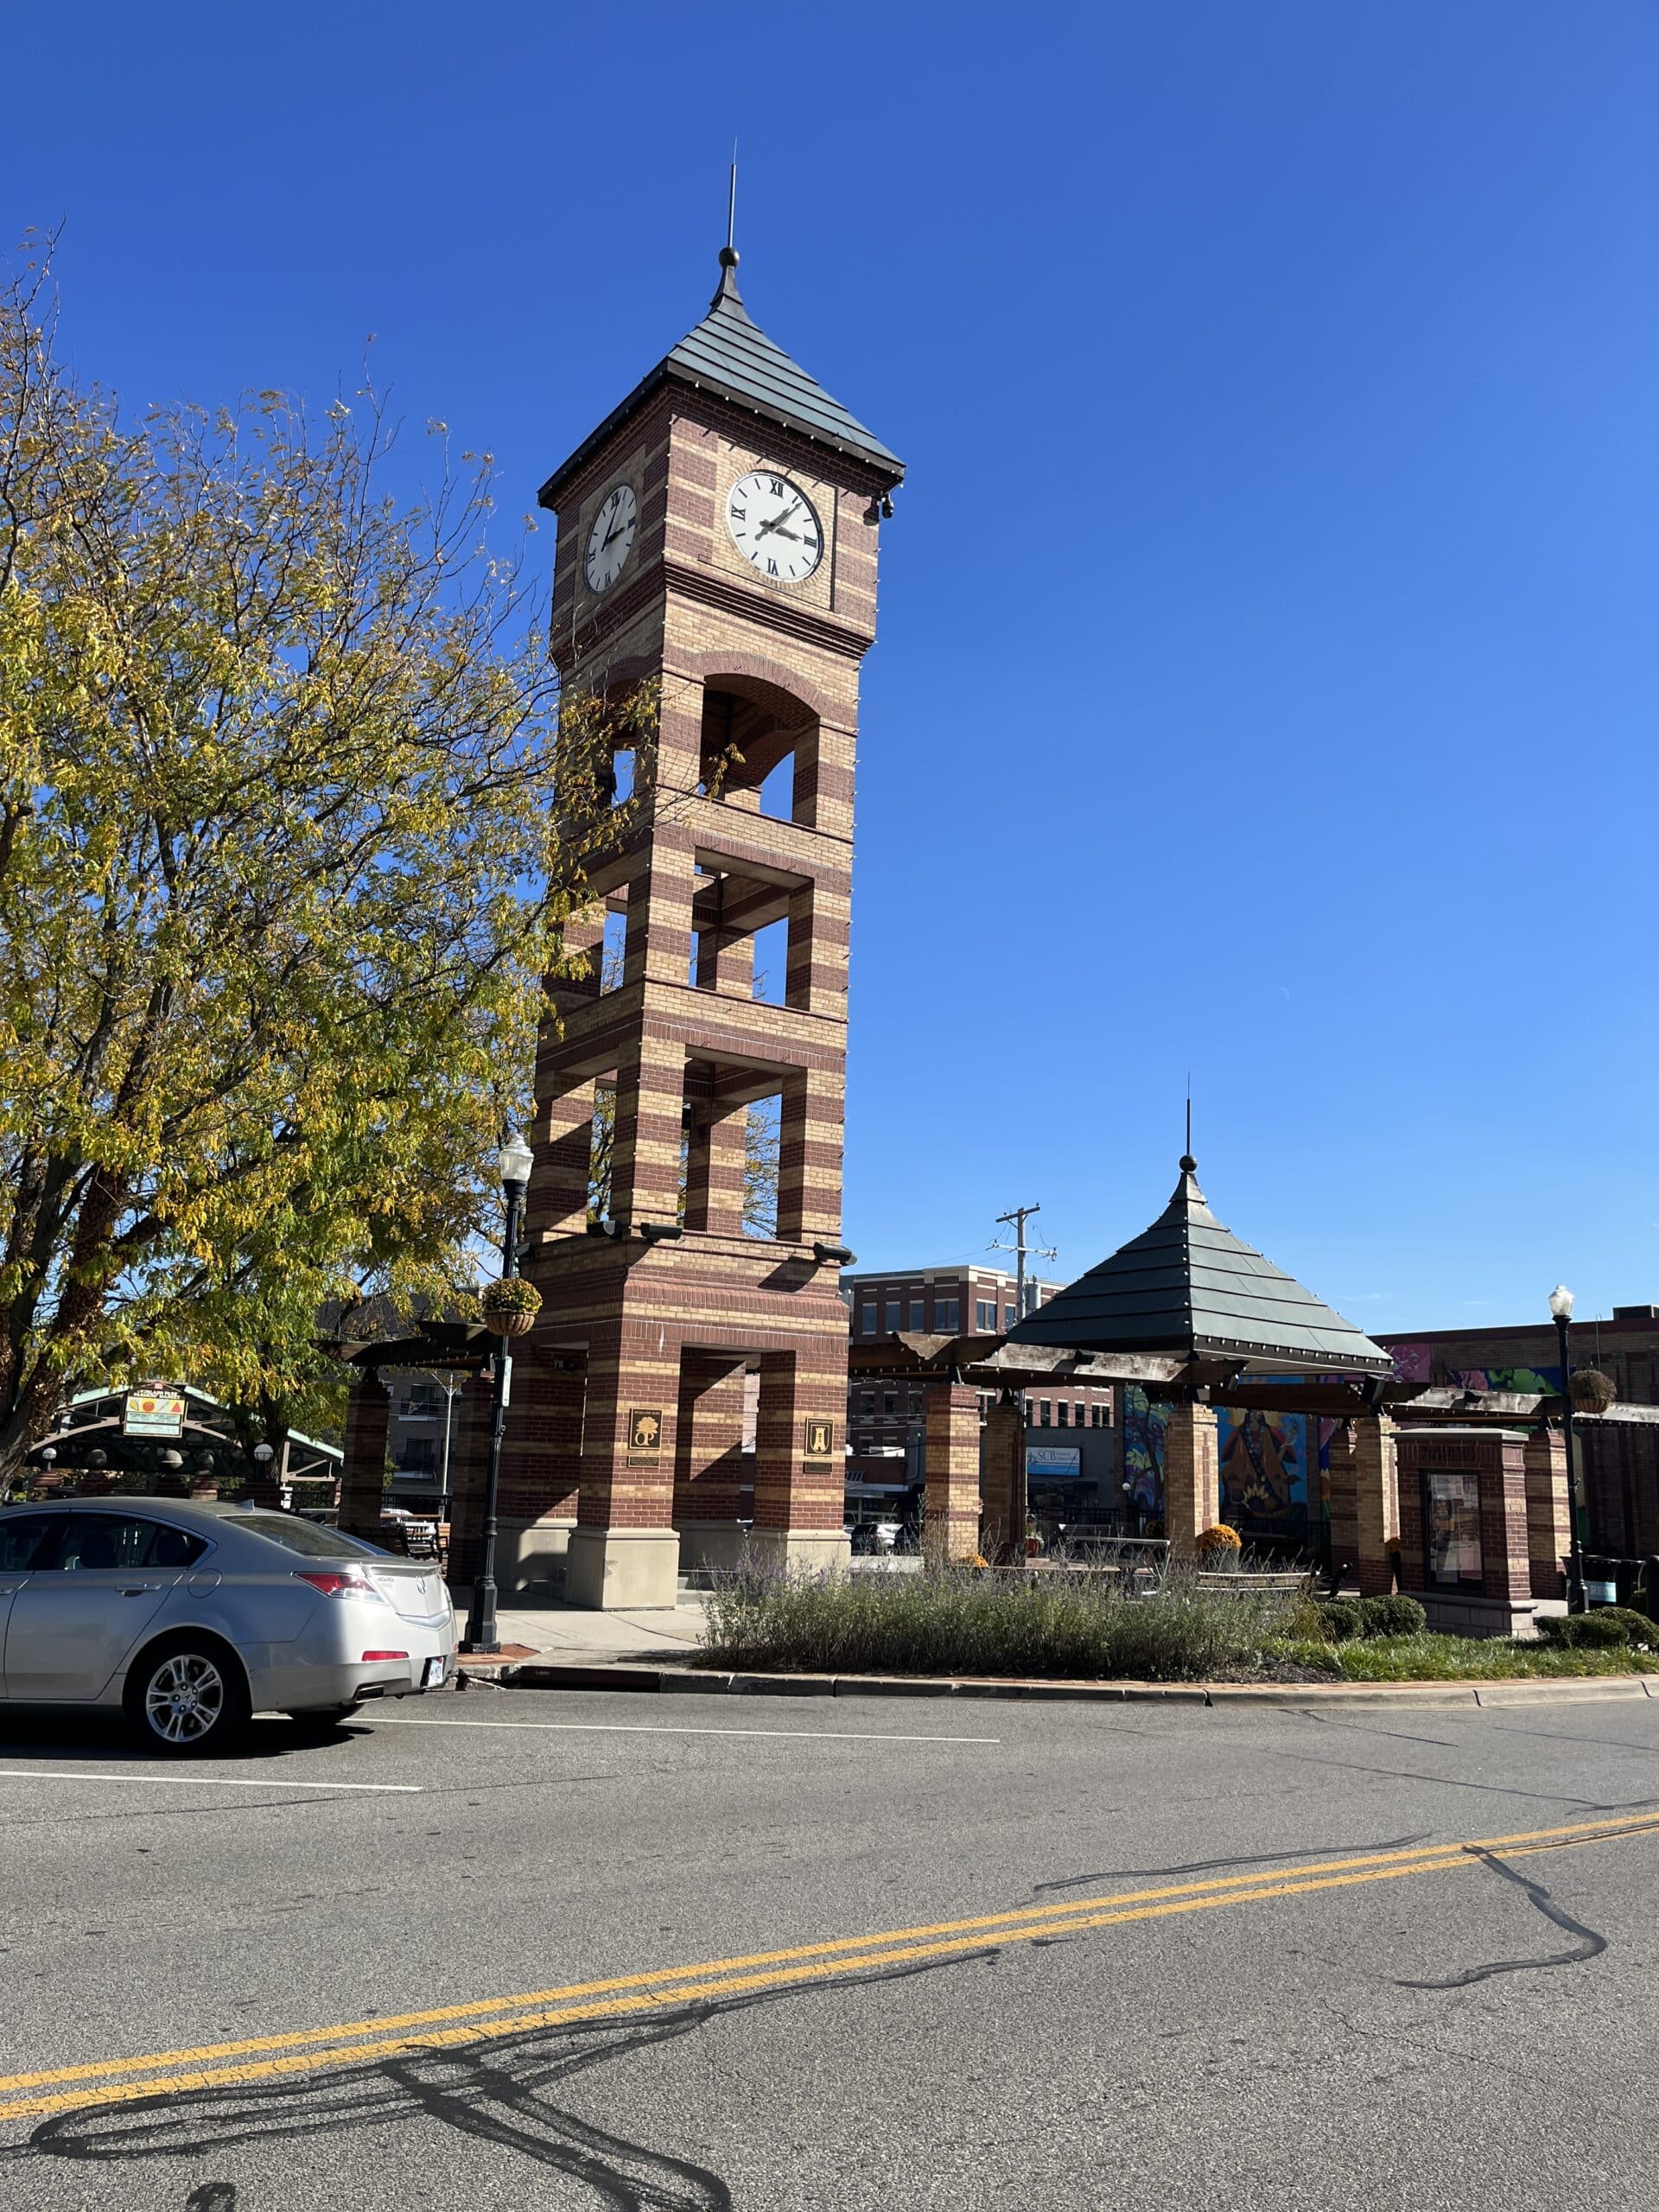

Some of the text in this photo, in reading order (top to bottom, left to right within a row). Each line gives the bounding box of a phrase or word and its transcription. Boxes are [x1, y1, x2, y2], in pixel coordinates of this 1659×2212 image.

[770, 479, 785, 499] XII
[731, 503, 747, 522] IX
[804, 534, 817, 550] III
[767, 557, 779, 577] VI
[1037, 1451, 1057, 1461] SCB
